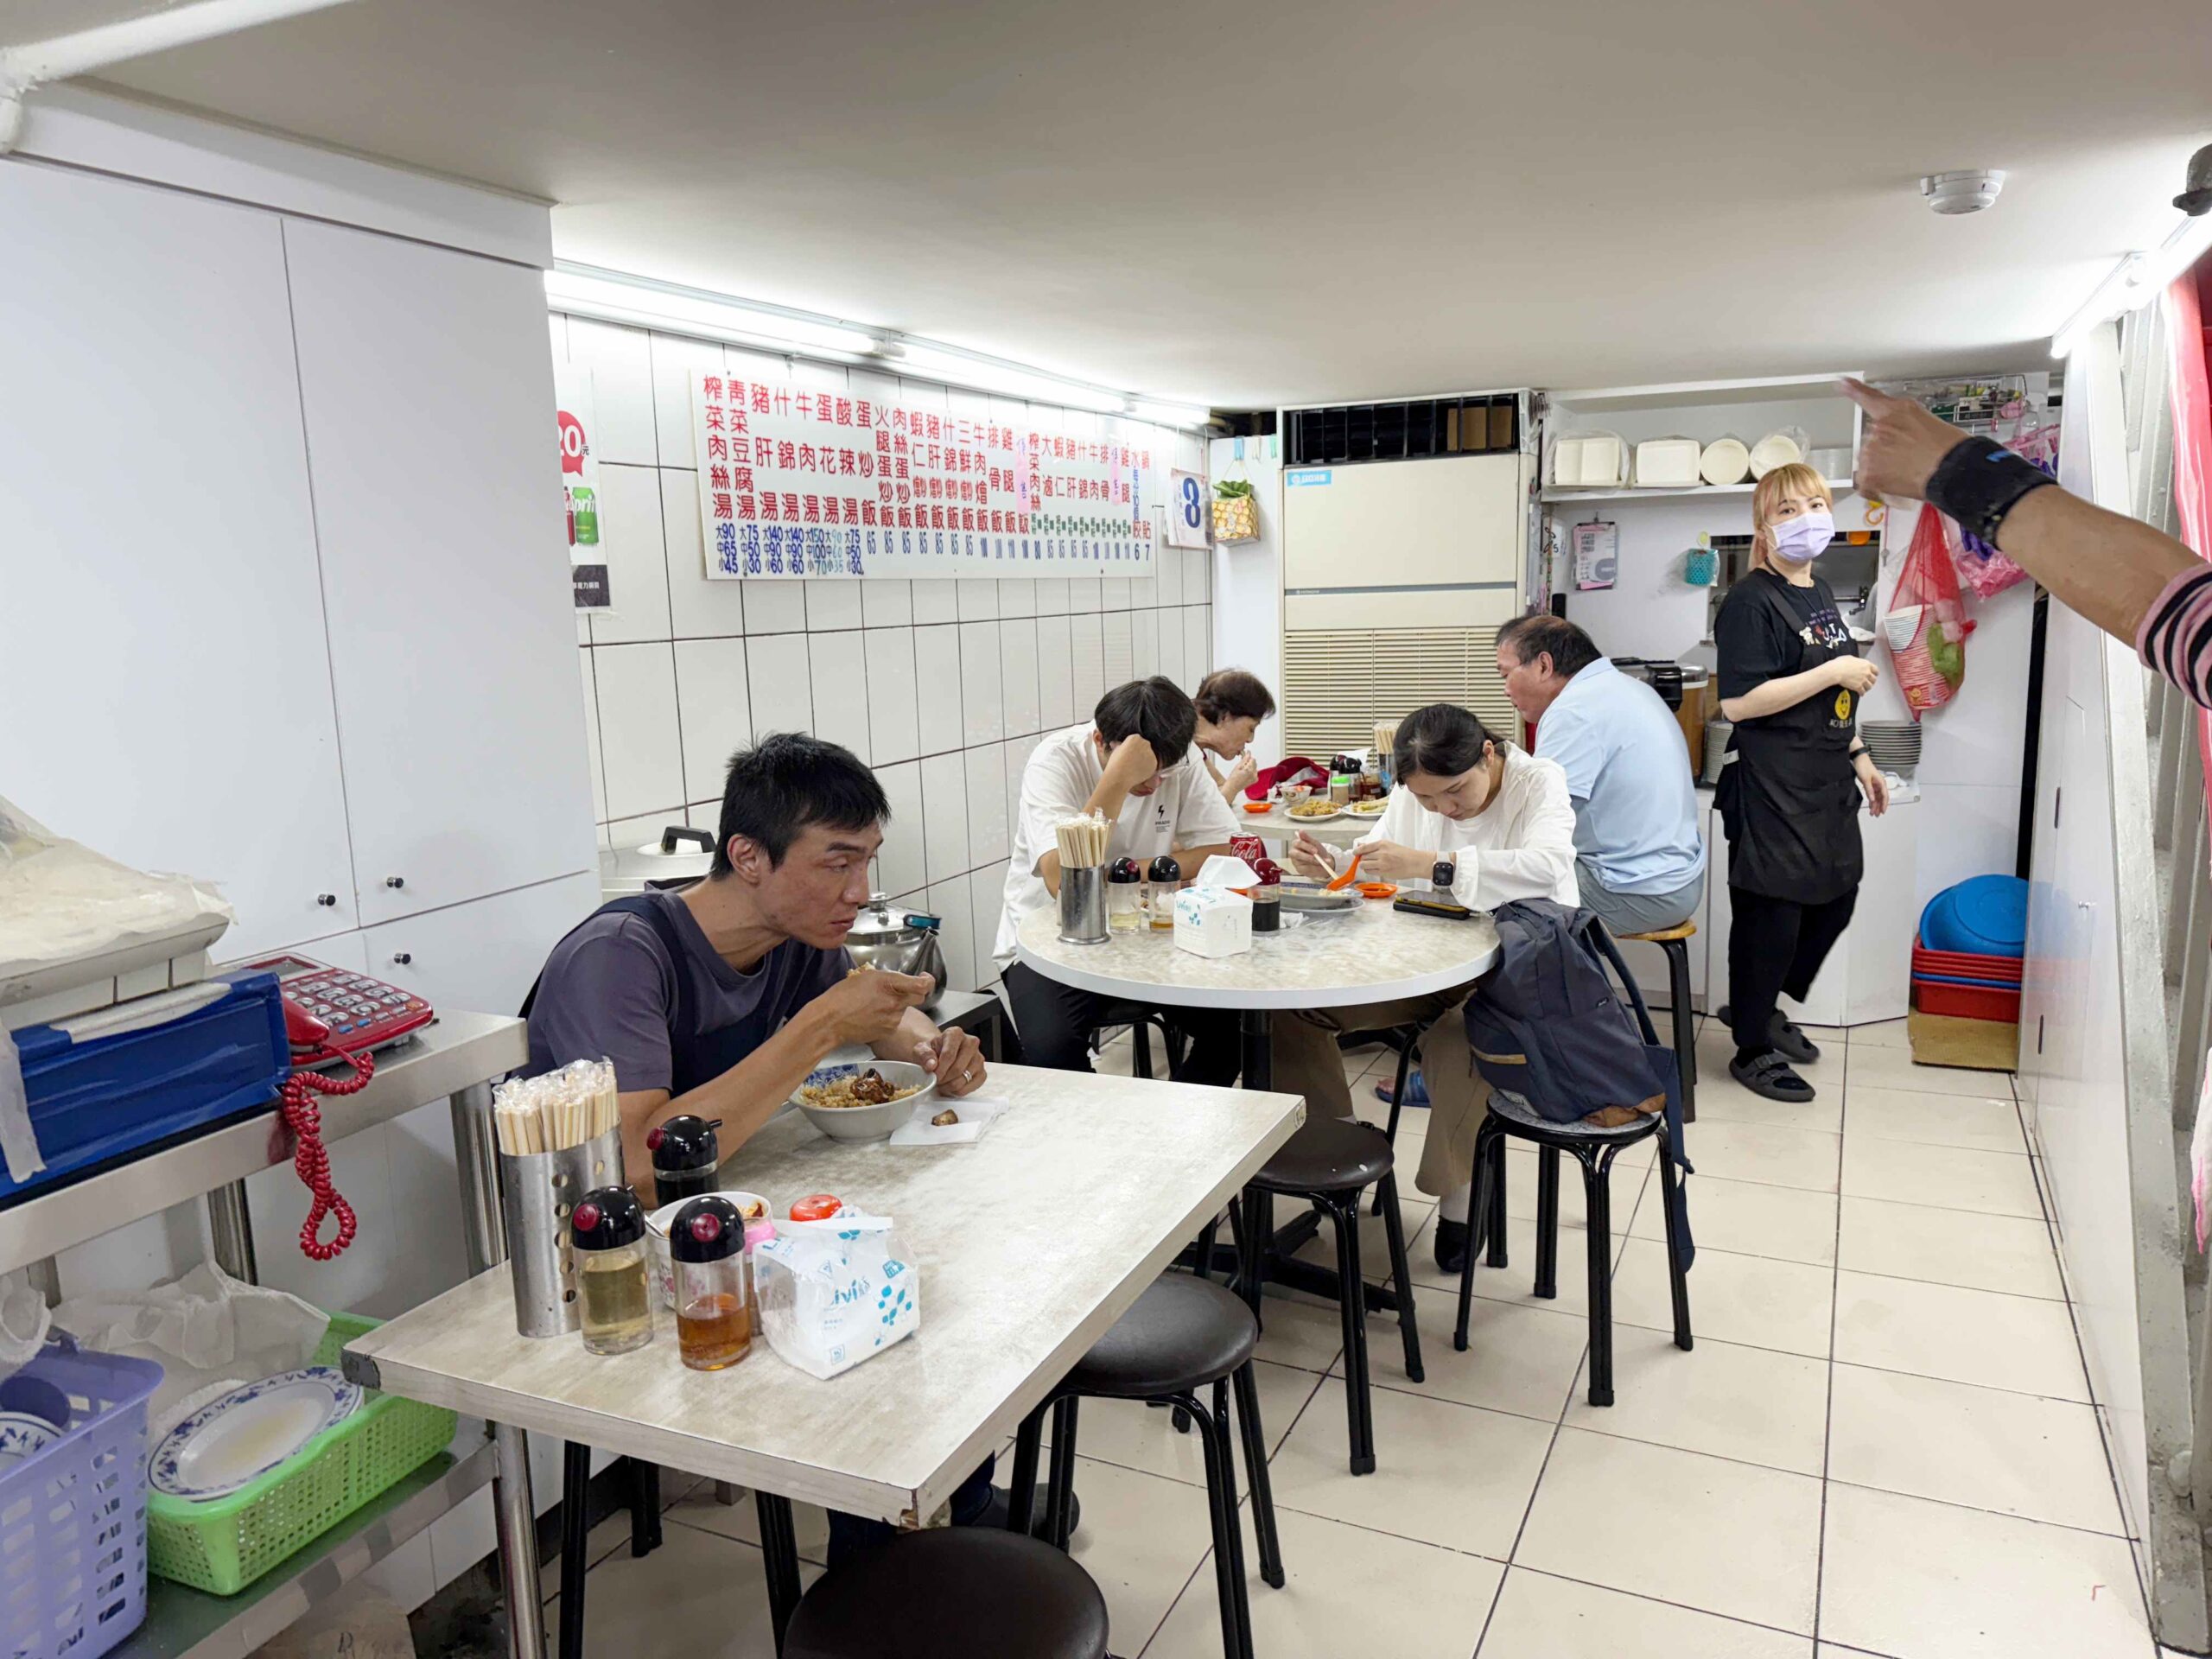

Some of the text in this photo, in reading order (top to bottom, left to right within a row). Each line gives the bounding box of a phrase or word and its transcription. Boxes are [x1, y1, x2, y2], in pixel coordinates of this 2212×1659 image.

[703, 375, 733, 520] 榨菜肉絲湯
[727, 379, 756, 521] 青菜豆腐湯
[750, 383, 779, 522] 豬肝湯
[774, 387, 799, 523] 什錦湯
[795, 391, 820, 524] 牛肉湯
[816, 393, 840, 524] 蛋花湯
[836, 397, 859, 526] 酸辣湯
[855, 400, 877, 526] 蛋炒飯
[874, 404, 895, 528] 火腿蛋炒飯
[893, 407, 912, 528] 肉絲蛋炒飯
[973, 423, 989, 532] 牛肉燴飯
[988, 425, 1003, 533] 排骨飯
[715, 523, 735, 540] 大90
[740, 524, 759, 541] 大75
[762, 525, 783, 542] 大140
[785, 526, 804, 542] 大140
[805, 527, 824, 543] 大150
[844, 529, 861, 544] 大75
[867, 531, 876, 554] 65
[884, 531, 893, 554] 85
[902, 531, 911, 554] 85
[919, 531, 928, 554] 85
[935, 531, 944, 555] 85
[716, 541, 737, 557] 中65
[741, 542, 760, 558] 中50
[763, 543, 782, 558] 中90
[785, 543, 804, 559] 中90
[845, 545, 861, 560] 中50
[718, 557, 739, 575] 小45
[742, 557, 761, 575] 小30
[765, 558, 784, 575] 小60
[786, 559, 804, 575] 小60
[846, 559, 862, 575] 小30
[830, 1279, 858, 1305] ivi
